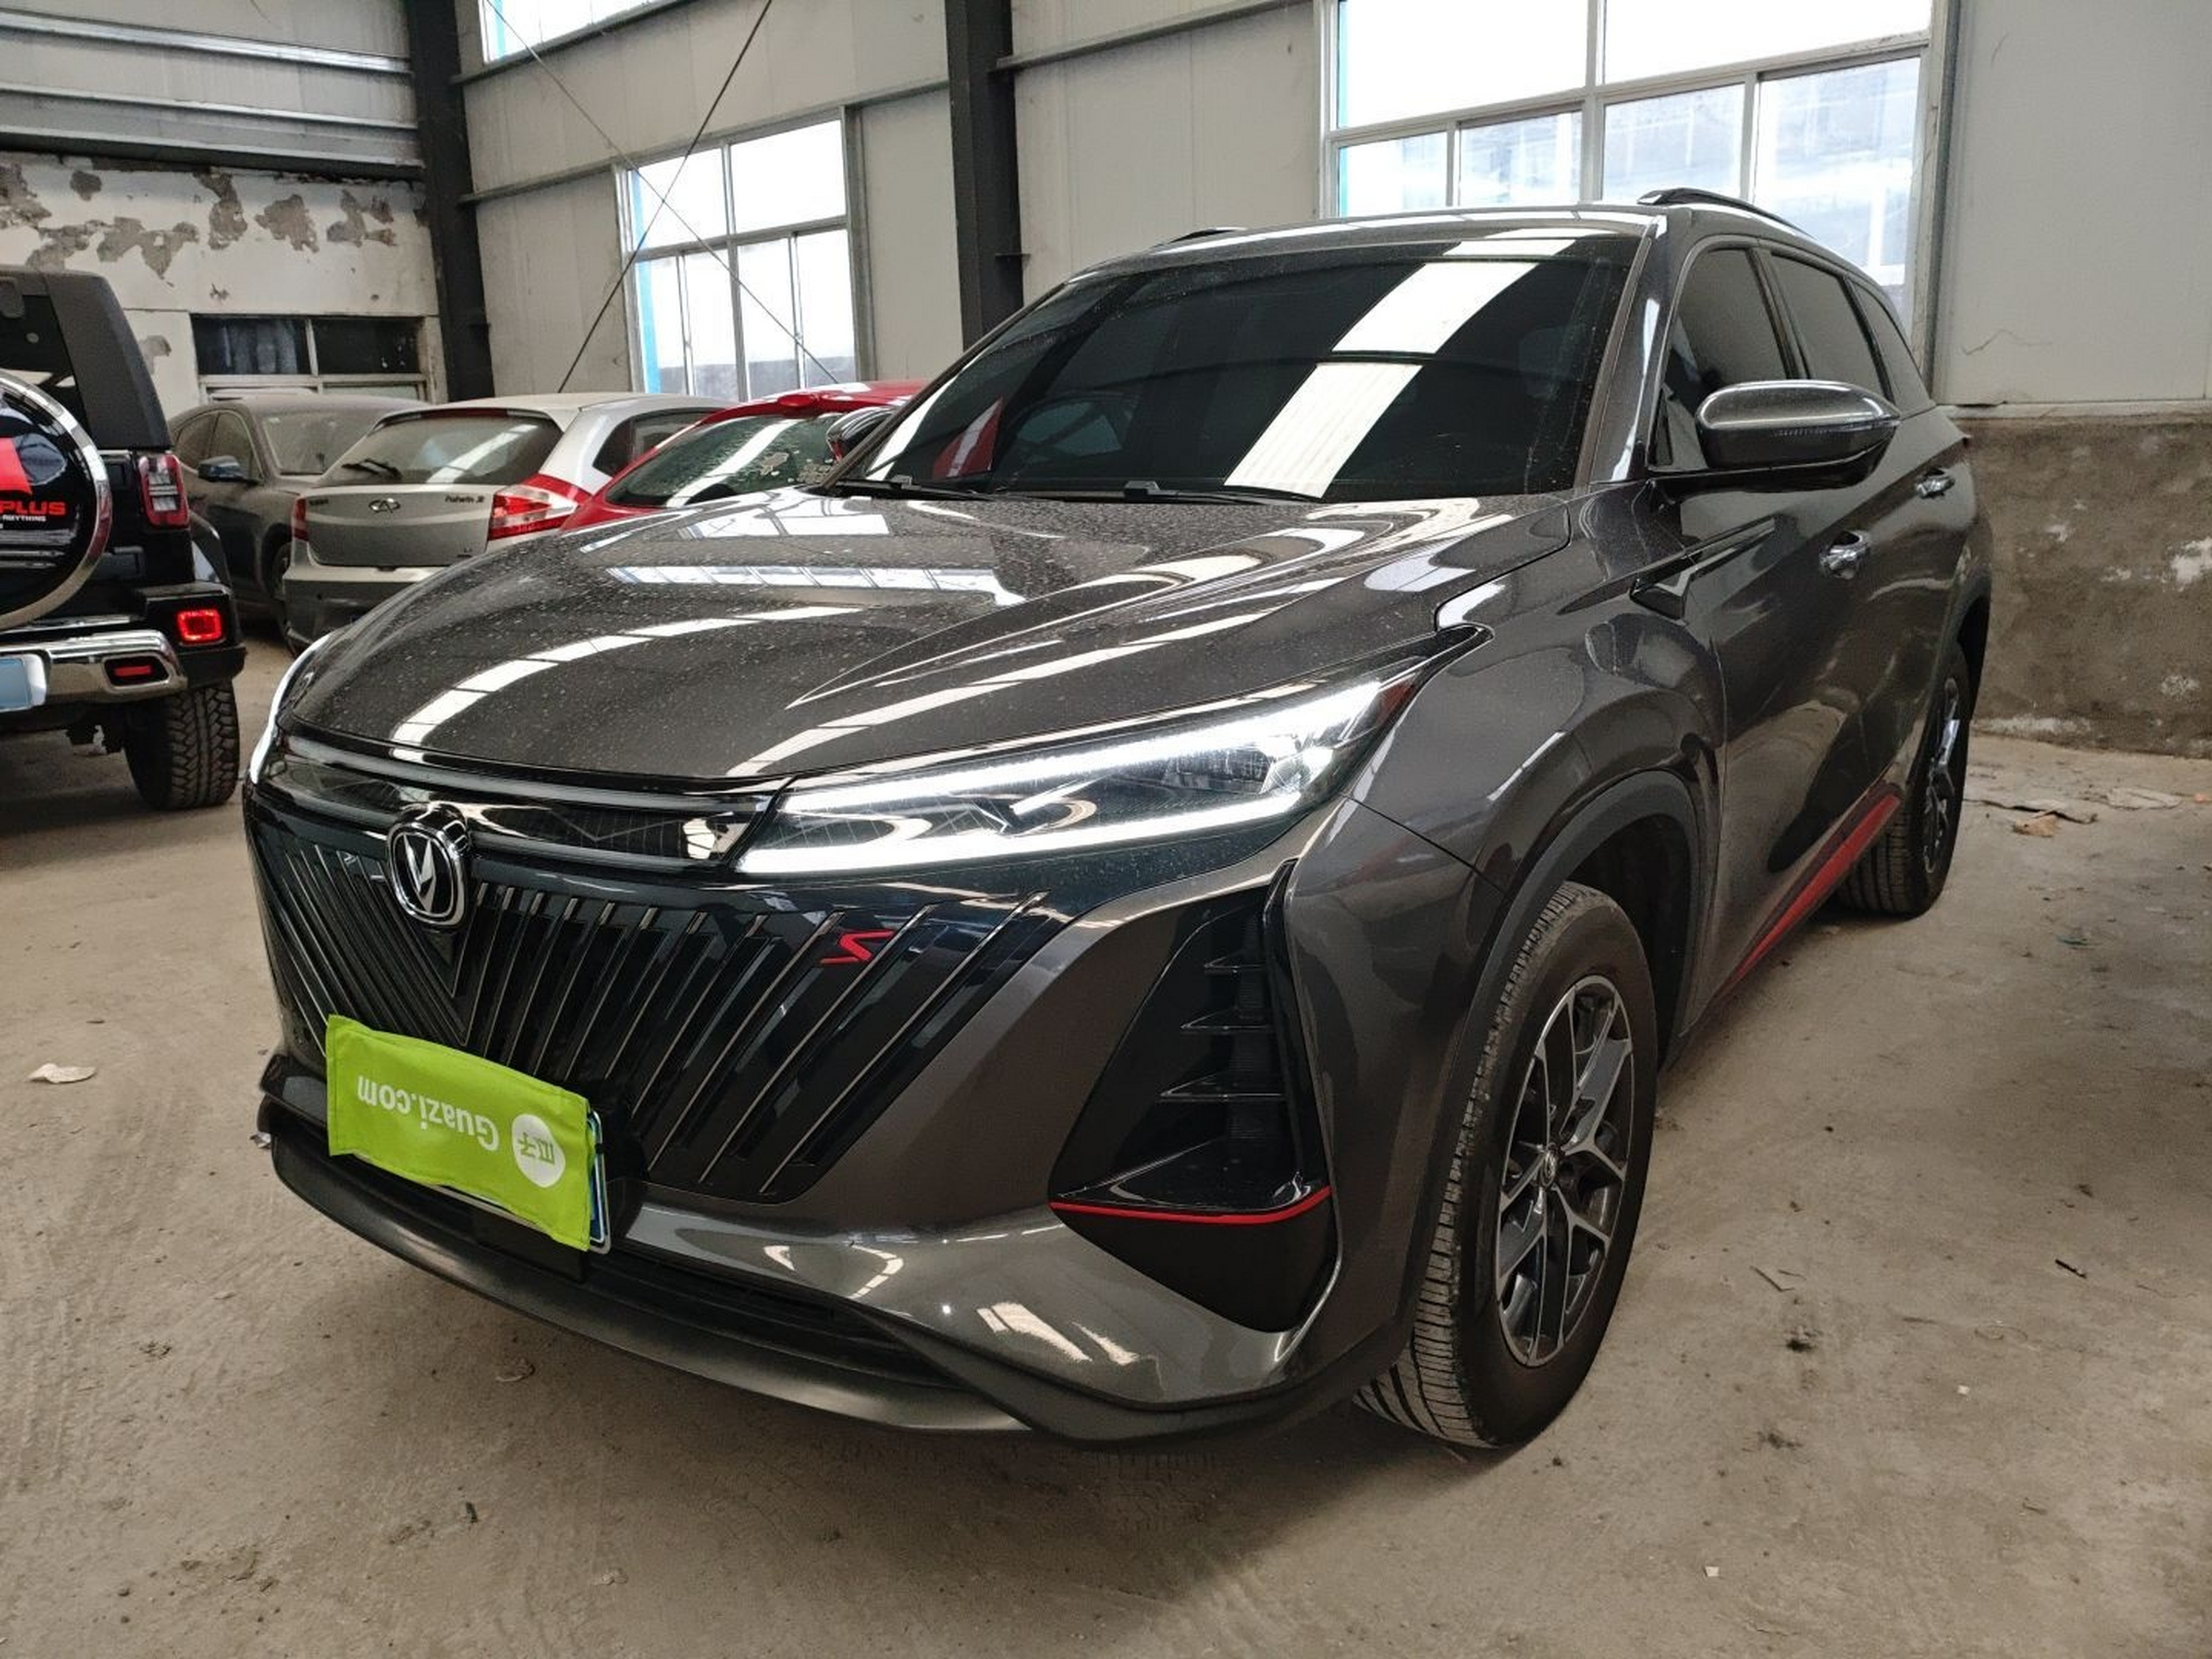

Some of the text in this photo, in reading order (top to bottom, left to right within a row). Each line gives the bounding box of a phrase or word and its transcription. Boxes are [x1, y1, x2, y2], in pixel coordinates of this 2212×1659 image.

[0, 501, 66, 515] PLUS
[357, 1075, 556, 1165] 瓜子 Guazi.com
